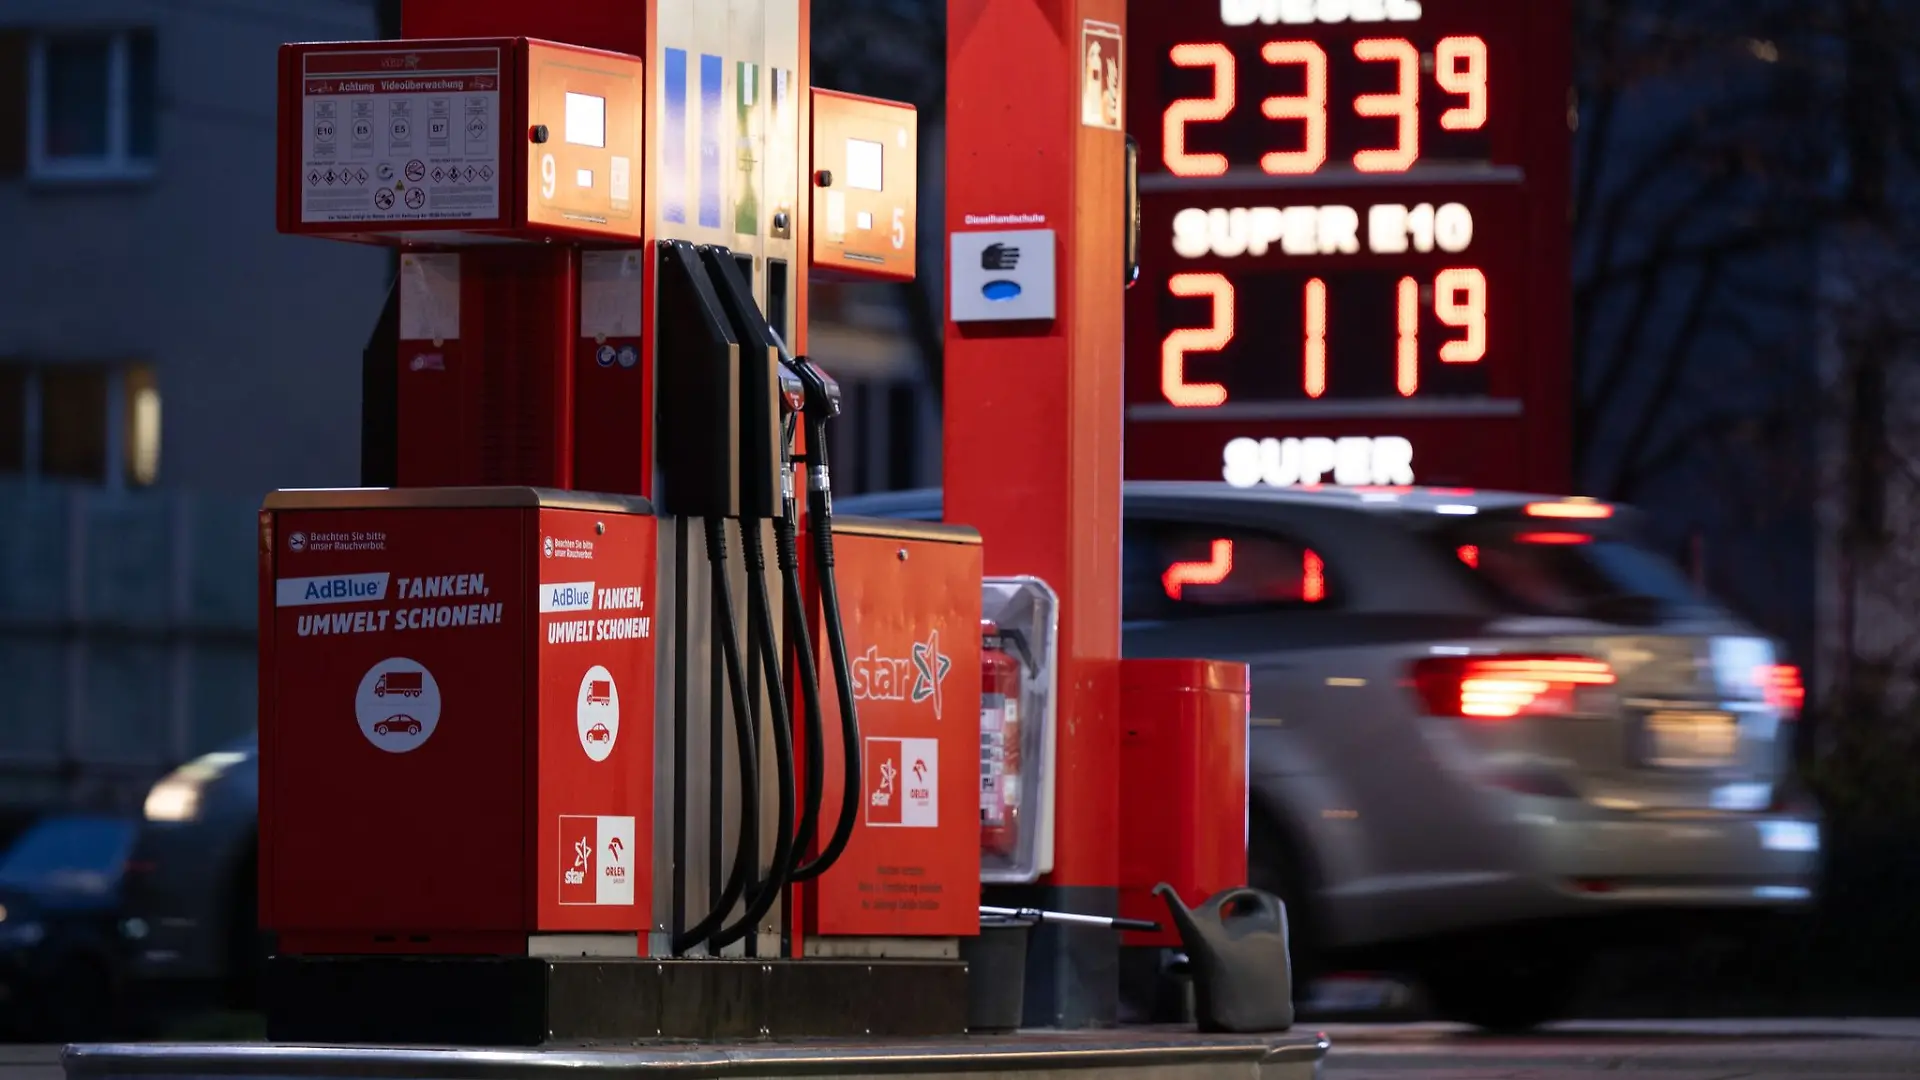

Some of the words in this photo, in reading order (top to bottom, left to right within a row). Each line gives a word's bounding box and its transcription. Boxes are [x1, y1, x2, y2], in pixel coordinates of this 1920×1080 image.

[338, 81, 375, 93] Achtung
[381, 79, 464, 91] Videoüberwachung
[317, 126, 333, 136] E10
[357, 125, 368, 134] E5
[394, 125, 406, 134] E5
[432, 124, 444, 133] B7
[541, 153, 556, 199] 9
[891, 207, 905, 249] 5
[1172, 205, 1360, 258] SUPER
[1368, 202, 1473, 253] E10
[1222, 436, 1415, 488] SUPER
[310, 532, 349, 542] Beachten
[352, 532, 364, 541] Sie
[366, 532, 386, 541] bitte
[554, 538, 575, 548] Beachten
[583, 541, 593, 549] bitte
[310, 542, 332, 550] unser
[334, 541, 387, 551] Rauchverbot.
[554, 549, 566, 558] unser
[397, 573, 490, 600] TANKEN,
[598, 586, 643, 611] TANKEN,
[297, 610, 390, 637] UMWELT
[394, 603, 503, 630] SCHONEN!
[548, 620, 595, 644] UMWELT
[596, 617, 650, 641] SCHONEN!
[852, 644, 910, 701] star
[872, 789, 891, 807] star
[565, 867, 584, 884] star
